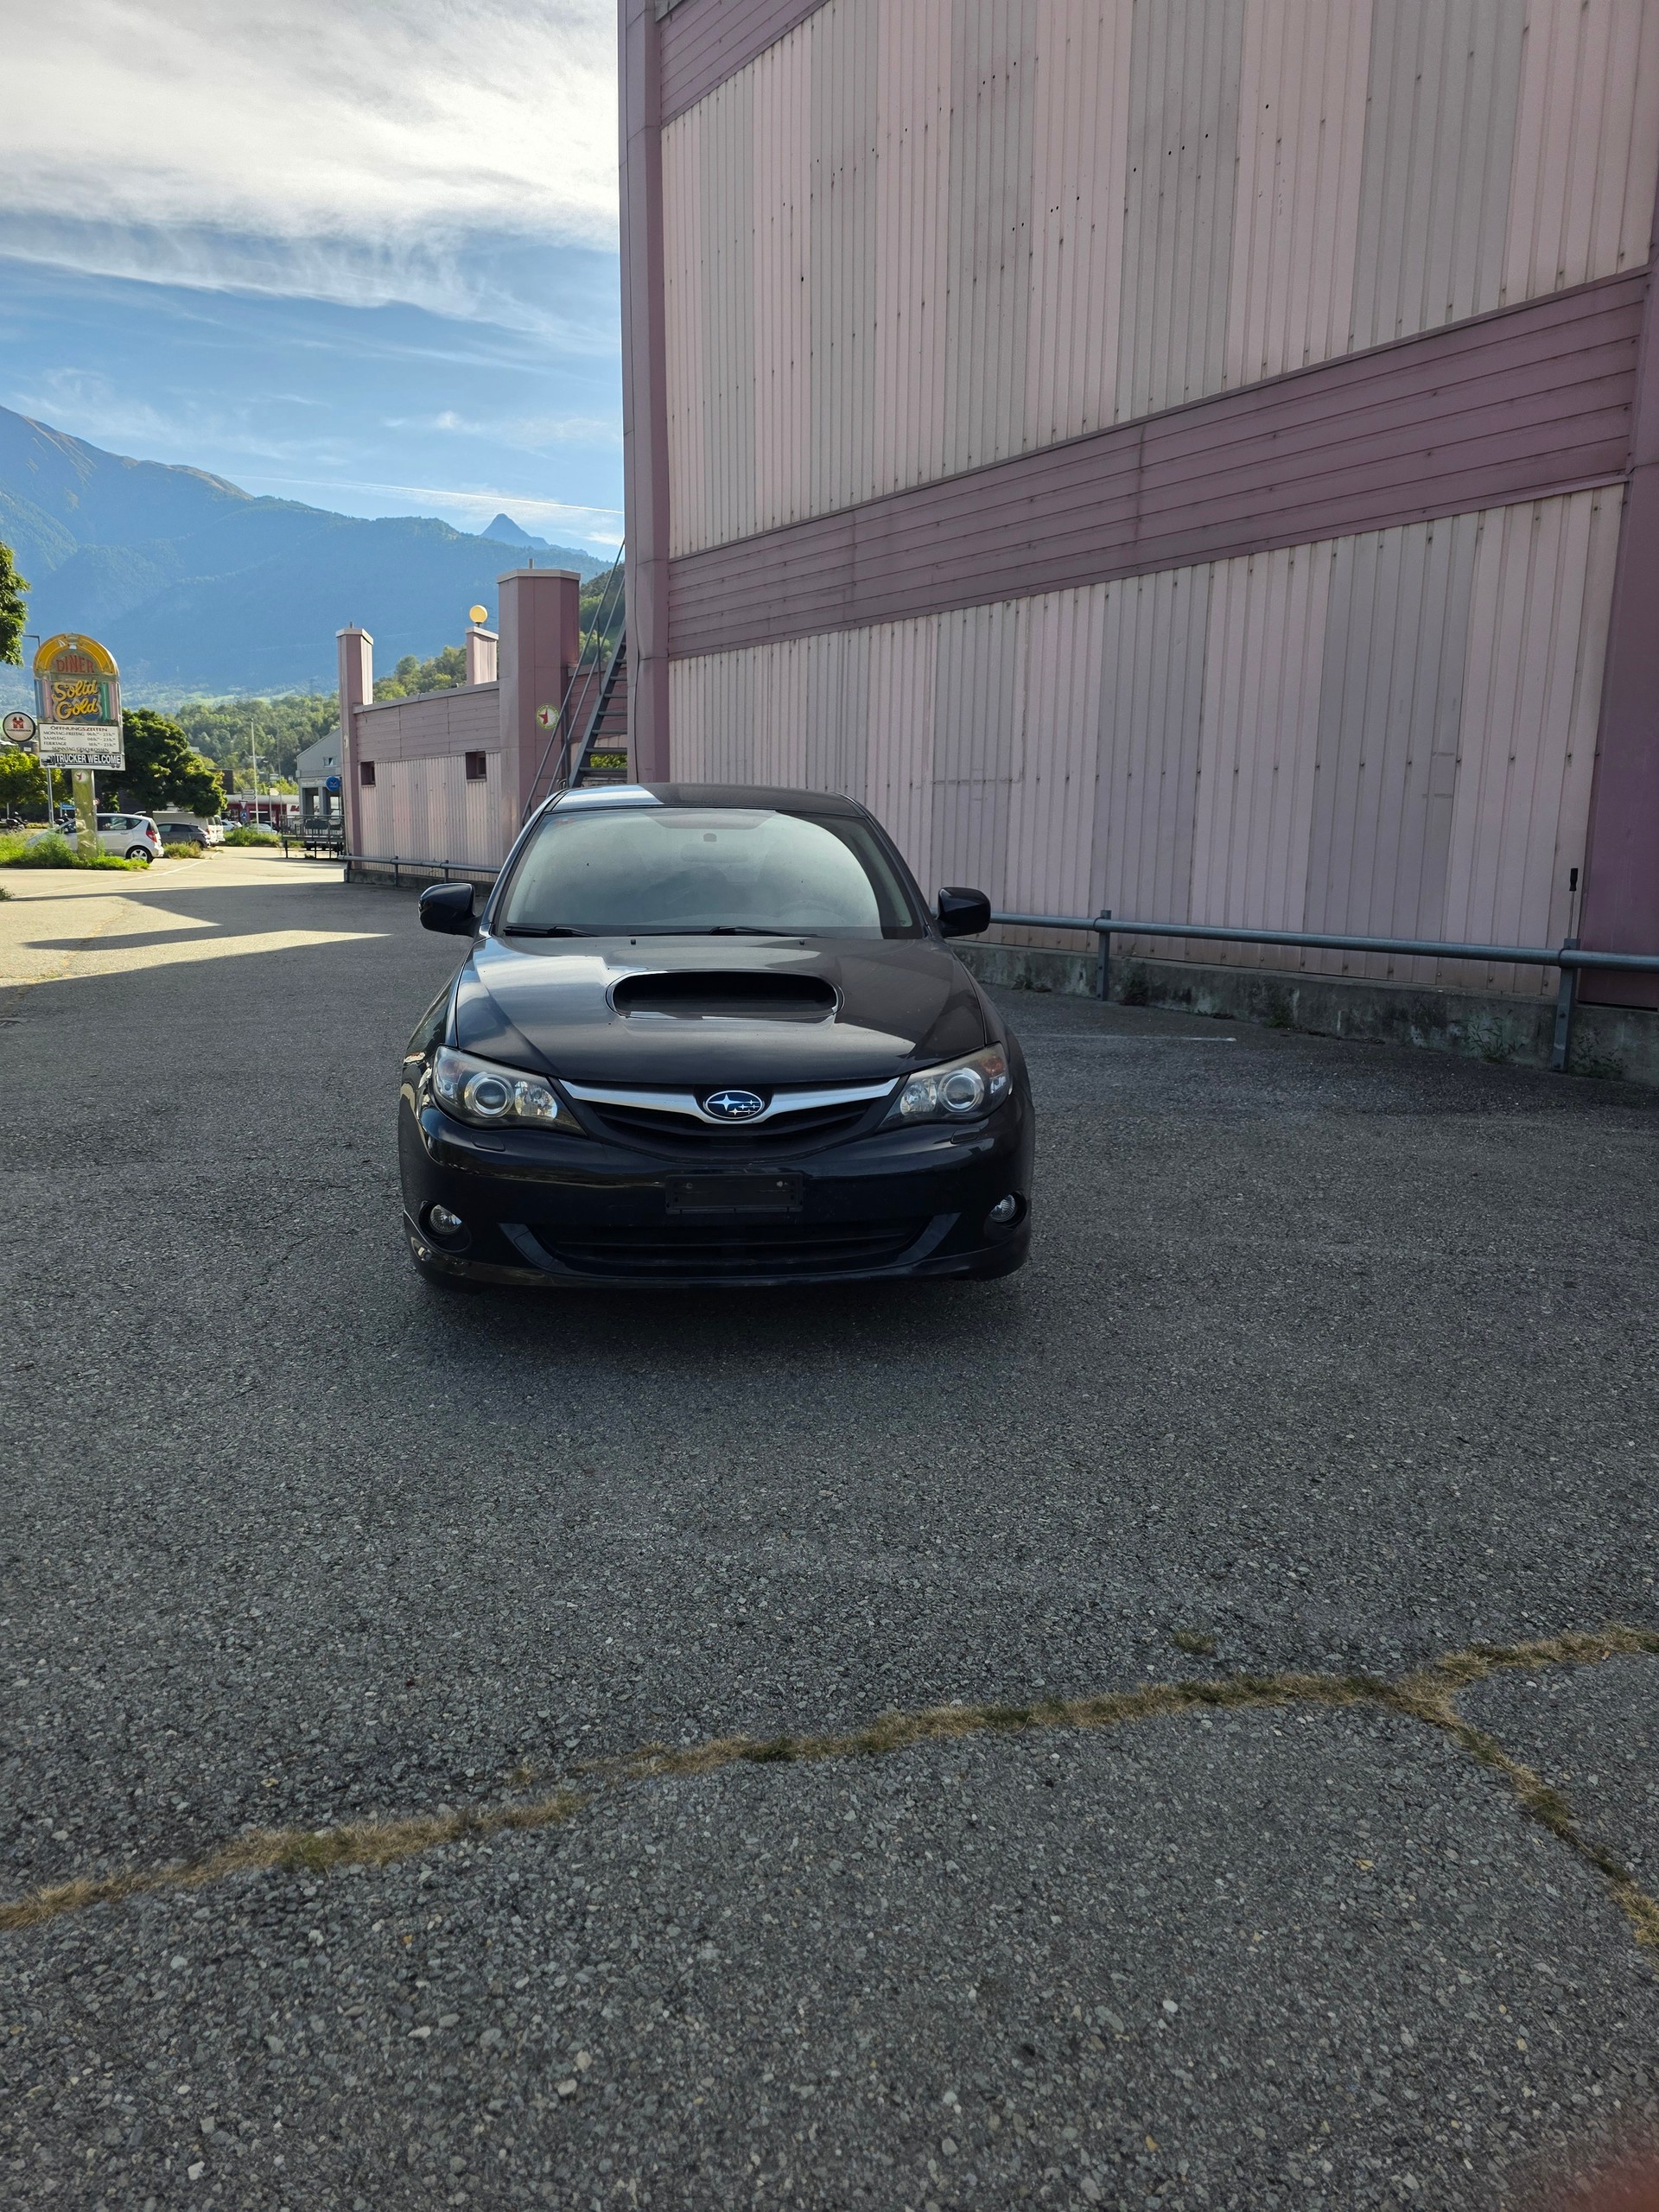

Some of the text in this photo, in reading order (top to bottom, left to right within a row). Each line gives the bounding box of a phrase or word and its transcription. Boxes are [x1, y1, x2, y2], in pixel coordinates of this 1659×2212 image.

[56, 655, 94, 672] DINER
[52, 680, 99, 702] Solid
[56, 698, 99, 720] Gold
[55, 753, 121, 765] TRUCKER WELCOME
